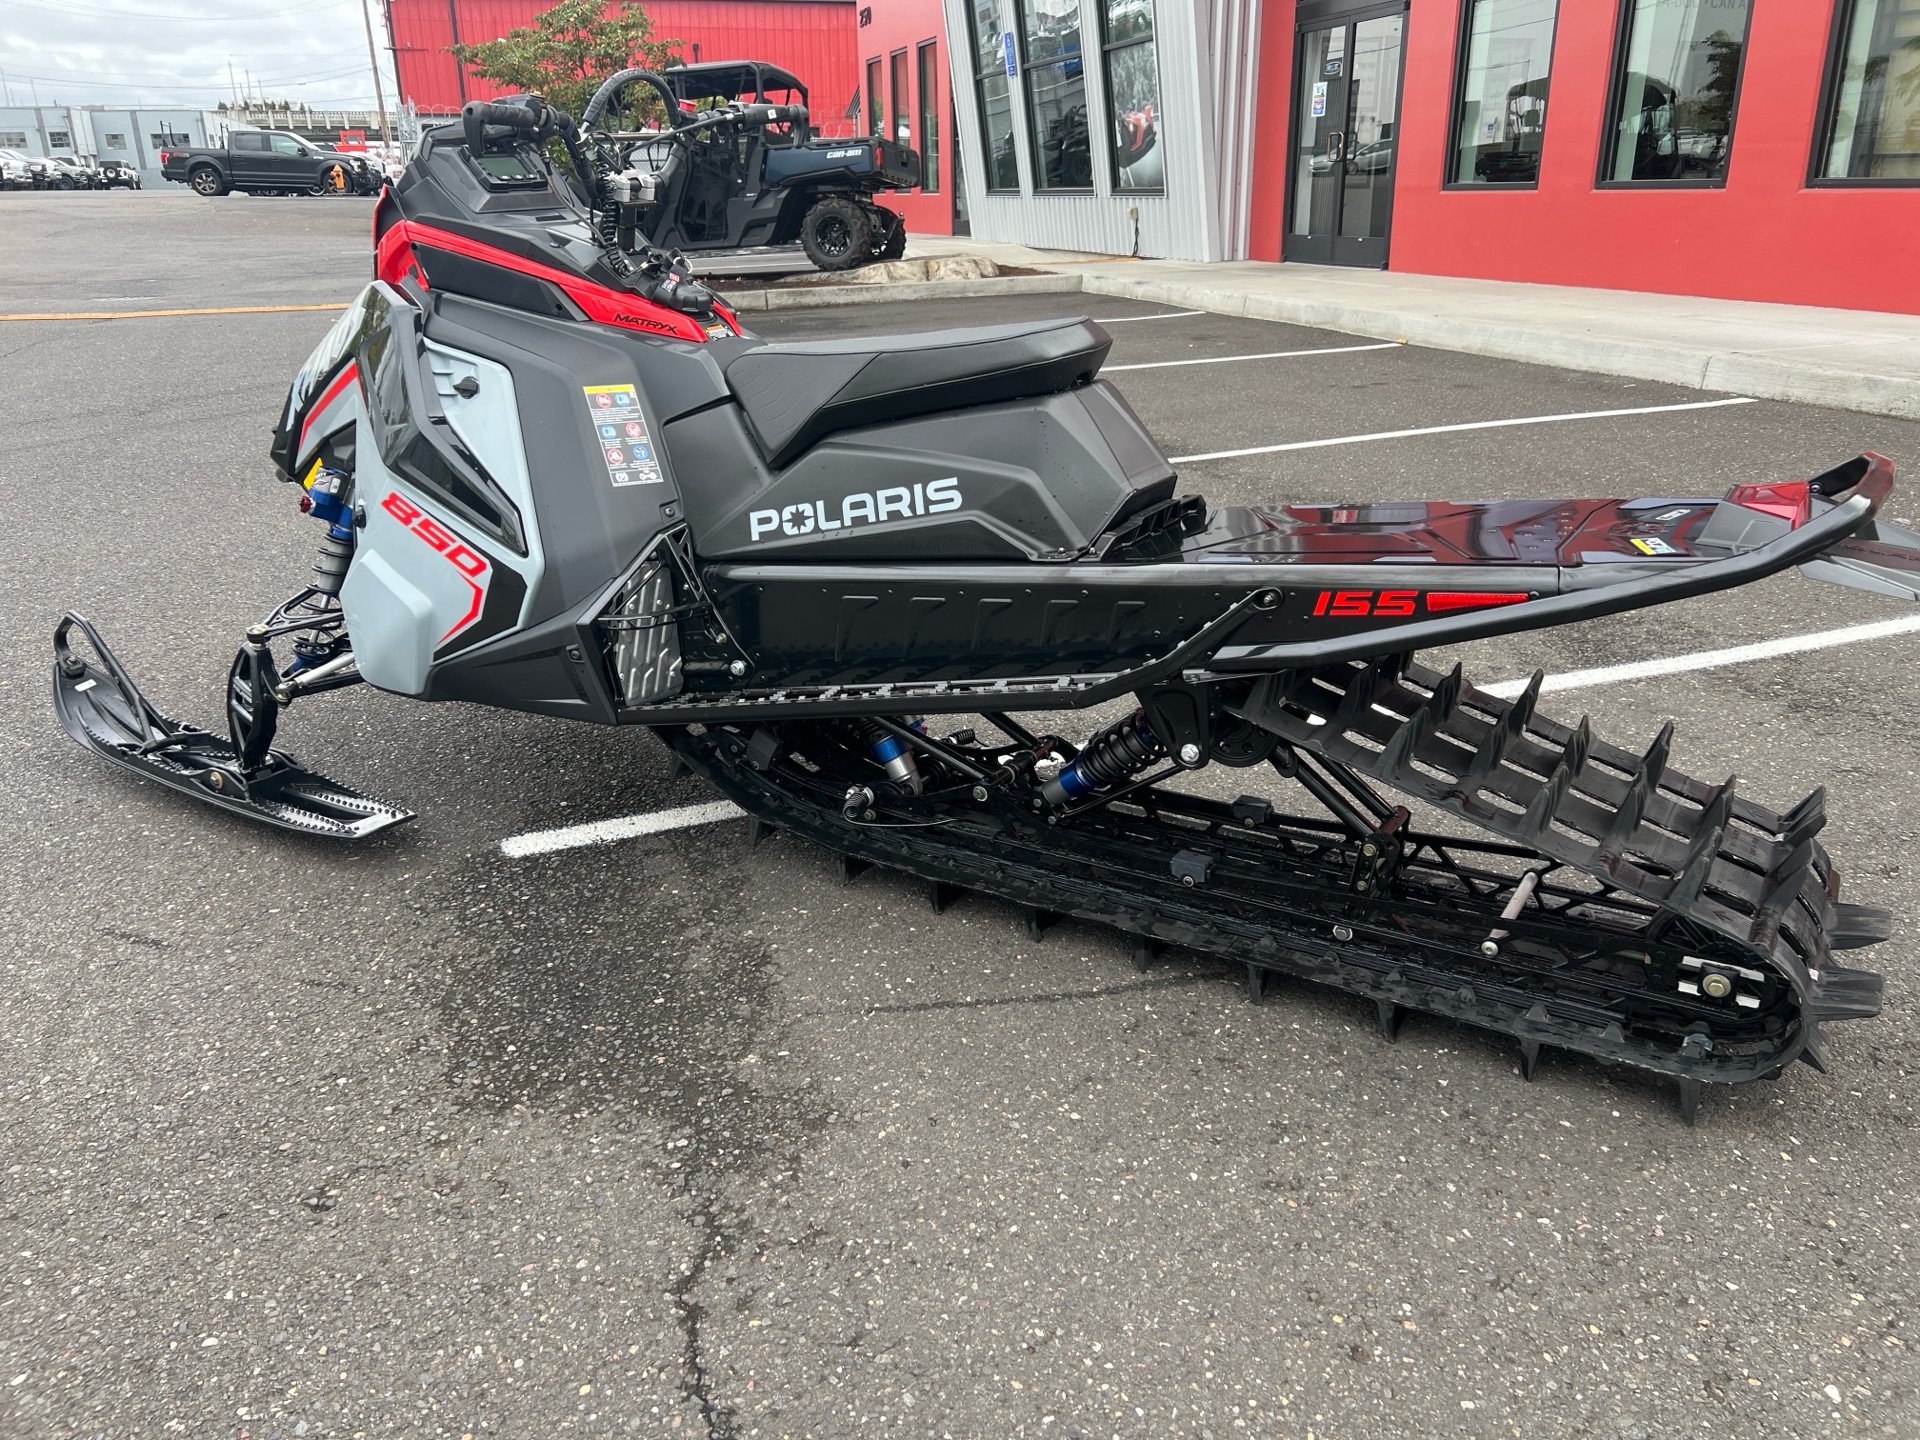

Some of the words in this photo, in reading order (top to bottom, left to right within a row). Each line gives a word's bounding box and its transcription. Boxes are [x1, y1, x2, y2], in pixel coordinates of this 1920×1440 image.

[613, 313, 678, 335] MATRYX
[749, 477, 963, 542] POLARIS
[380, 491, 488, 578] 850
[1313, 590, 1419, 616] 155
